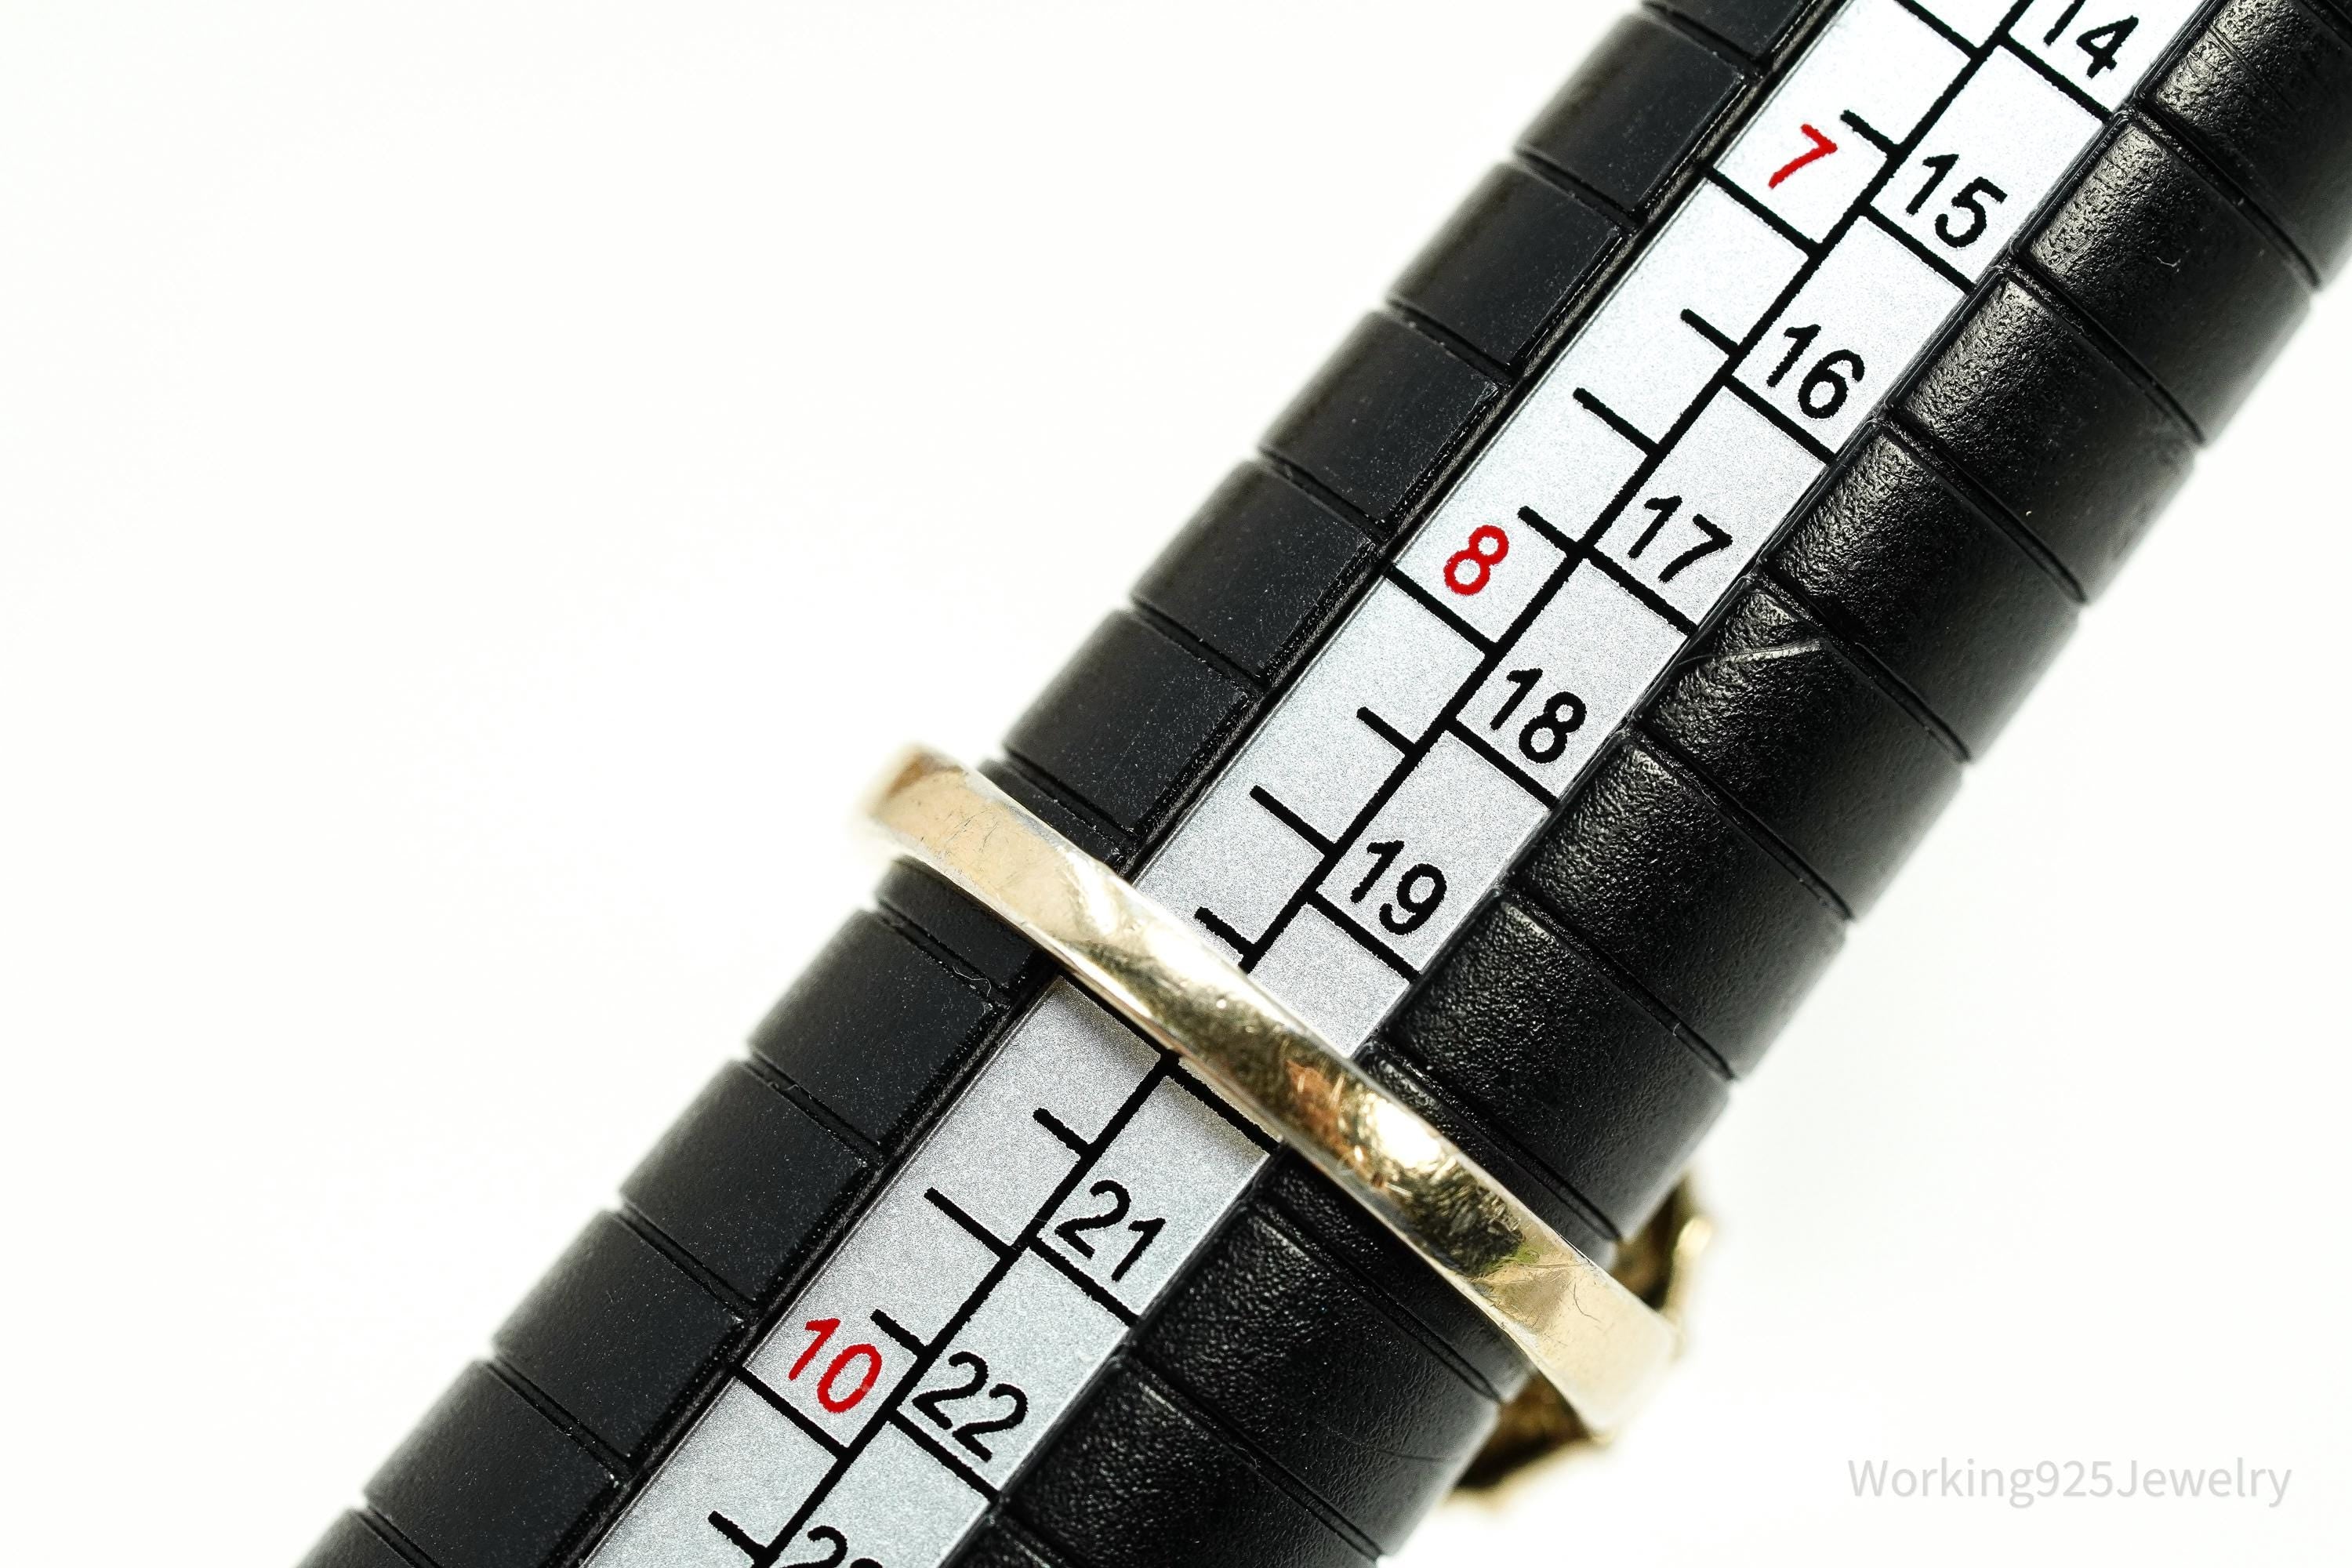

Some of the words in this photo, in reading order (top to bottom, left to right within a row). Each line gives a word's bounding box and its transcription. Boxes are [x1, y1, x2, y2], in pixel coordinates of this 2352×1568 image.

[1769, 124, 1837, 188] 7
[1906, 154, 2007, 249] 15
[1766, 325, 1865, 419] 16
[1443, 525, 1508, 595] 8
[1628, 495, 1733, 583] 17
[1490, 668, 1587, 764] 18
[1350, 840, 1447, 935] 19
[1054, 1180, 1166, 1283] 21
[789, 1318, 882, 1413] 10
[912, 1352, 1029, 1463] 22
[781, 1526, 883, 1568] 2
